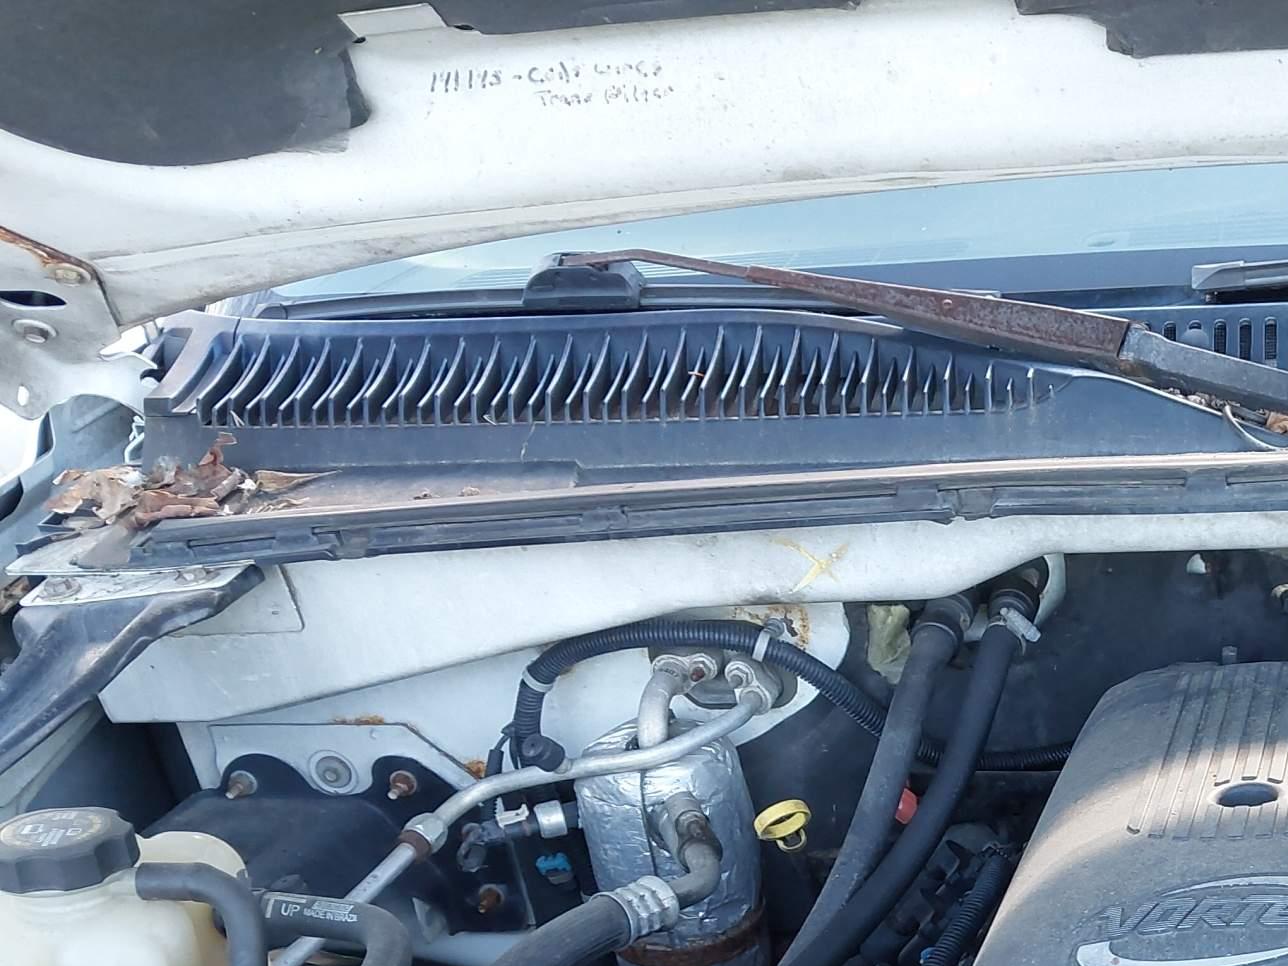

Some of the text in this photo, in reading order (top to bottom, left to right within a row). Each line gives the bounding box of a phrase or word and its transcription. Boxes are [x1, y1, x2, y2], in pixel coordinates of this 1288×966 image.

[280, 903, 300, 917] UP
[303, 907, 326, 920] MADE
[333, 912, 359, 923] BRAZIL
